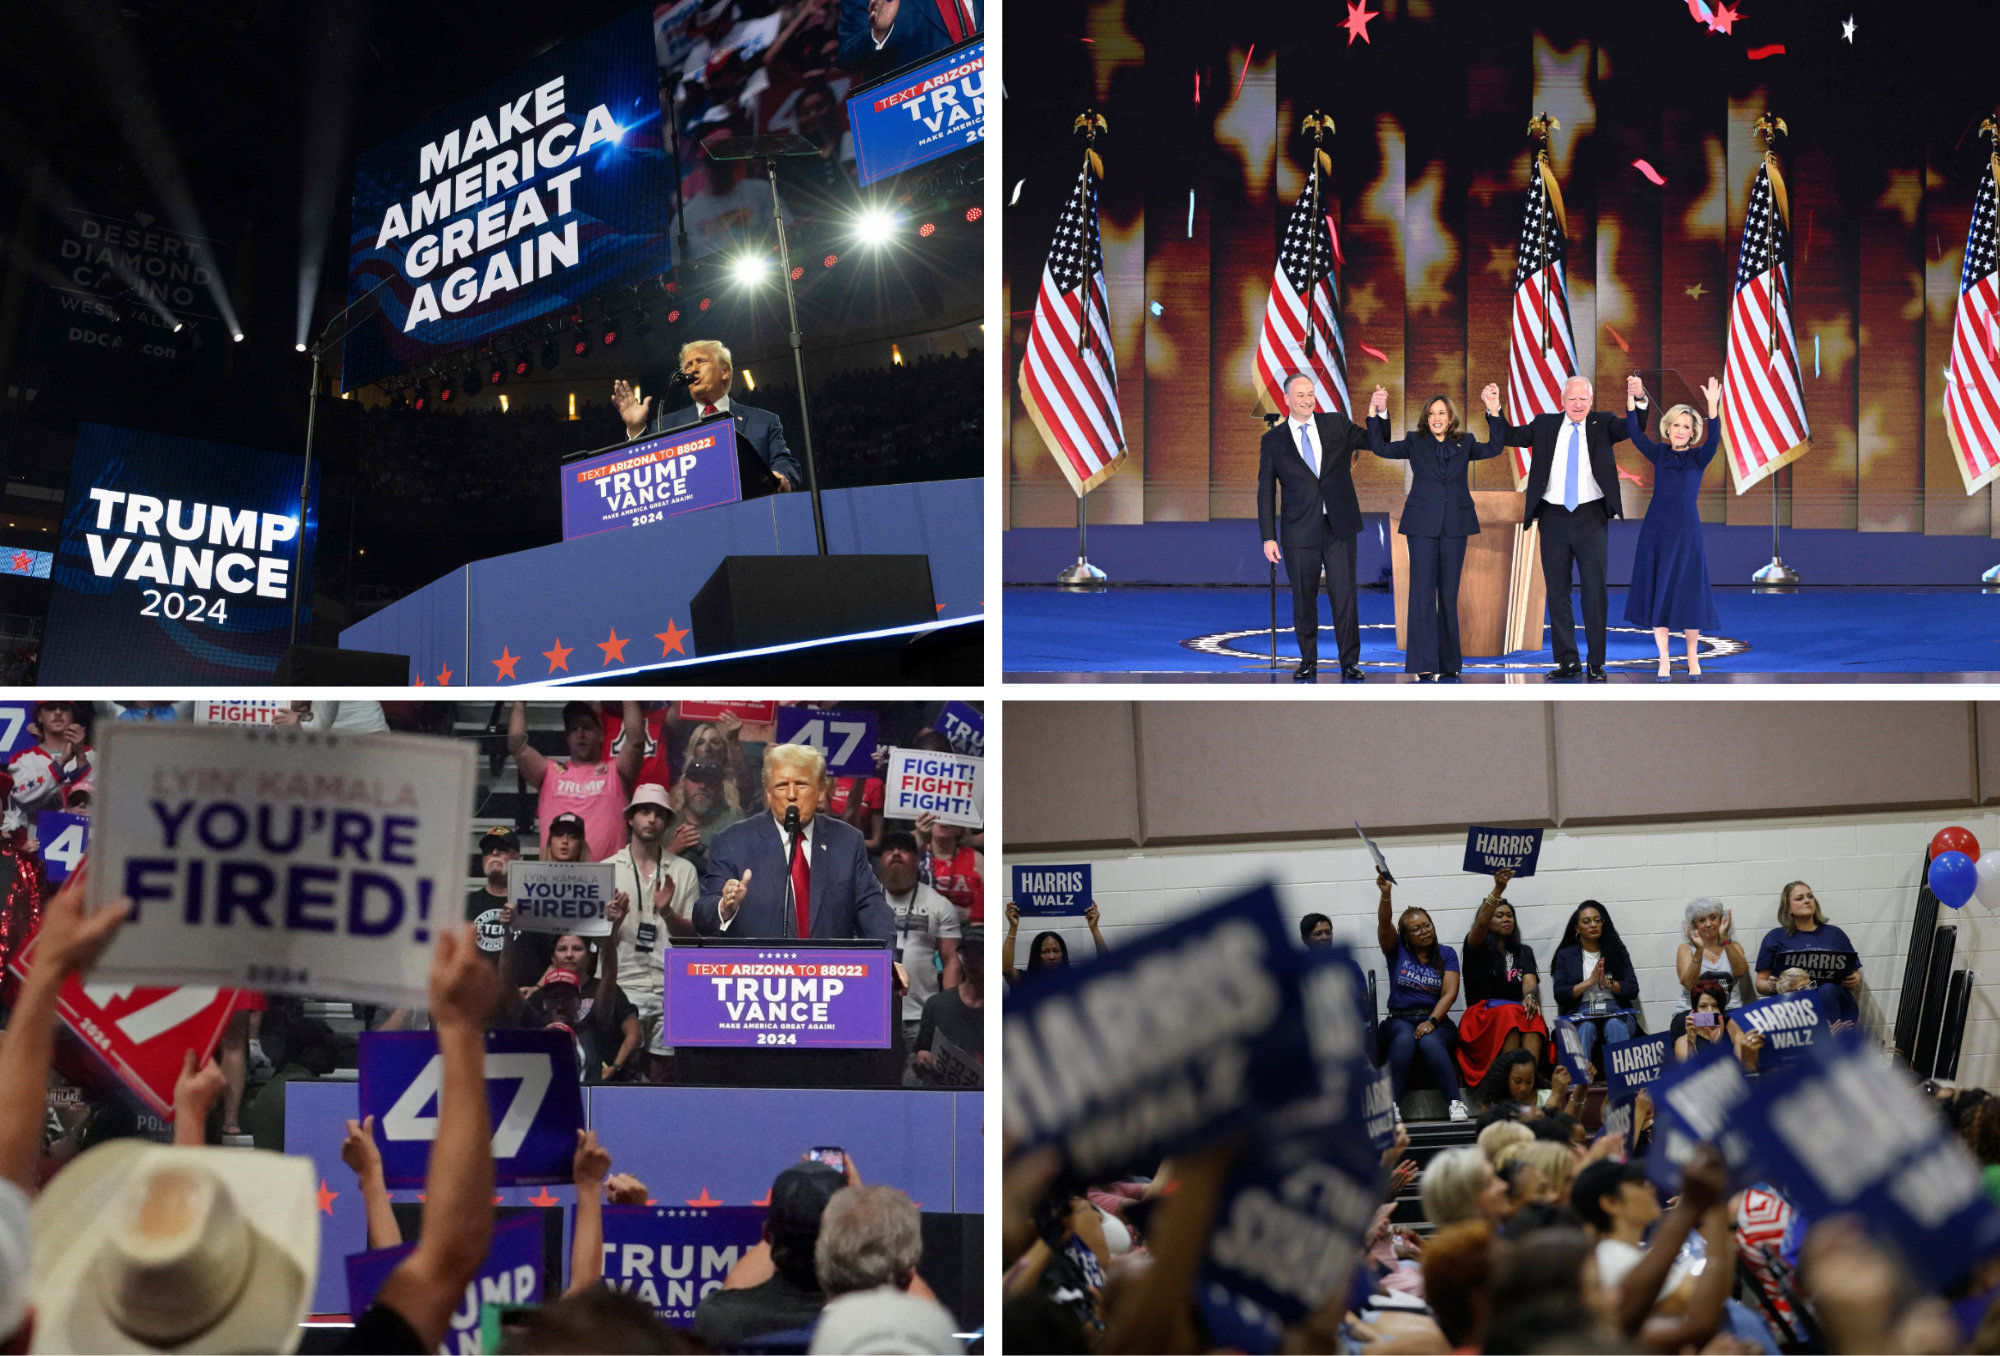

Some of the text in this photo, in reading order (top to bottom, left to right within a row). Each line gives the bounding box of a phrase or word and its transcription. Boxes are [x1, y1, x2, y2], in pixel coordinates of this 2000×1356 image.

[880, 86, 917, 109] TEXT
[419, 75, 565, 183] MAKE
[918, 132, 944, 146] MAKE
[375, 103, 622, 250] AMERICA
[405, 166, 581, 278] GREAT
[80, 219, 202, 260] DESERT
[60, 239, 212, 285] DIAMOND
[72, 266, 194, 306] CAINO
[404, 220, 579, 333] AGAIN
[581, 438, 711, 481] TEXT ARIZONA TO 88022
[595, 454, 697, 498] TRUMP
[606, 477, 687, 512] VANCE
[89, 487, 297, 552] TRUMP
[602, 512, 620, 521] MAKE
[621, 505, 648, 517] AMERICA
[649, 500, 670, 510] GREAT
[632, 510, 664, 527] 2024
[85, 533, 290, 599] VANCE
[140, 589, 228, 625] 2024
[787, 719, 867, 766] 47
[904, 759, 975, 780] FIGHT!
[558, 779, 605, 793] TRUMP
[901, 775, 974, 798] FIGHT!
[899, 792, 971, 815] FIGHT!
[150, 799, 420, 866] YOU'RE
[1476, 833, 1534, 855] HARRIS
[1485, 855, 1522, 868] WALZ
[523, 883, 599, 899] YOU'RE
[1022, 872, 1083, 893] HARRIS
[124, 856, 434, 944] FIRED!
[516, 899, 605, 919] FIRED!
[1032, 894, 1074, 906] WALZ
[694, 964, 863, 977] TEXT ARIZONA TO 88022
[1402, 960, 1441, 978] KAMAL
[1784, 953, 1847, 970] HARRIS
[1808, 970, 1835, 979] ALZ
[711, 977, 844, 1002] TRUMP
[726, 1002, 828, 1022] VANCE
[1744, 999, 1819, 1034] HARRIS
[757, 1034, 797, 1045] 2024
[1771, 1029, 1814, 1050] WALZ
[1612, 1041, 1665, 1074] HARRIS
[1625, 1067, 1661, 1086] WALZ
[382, 1053, 553, 1158] 47
[601, 1243, 755, 1279] TRUM
[449, 1264, 536, 1330] UMP
